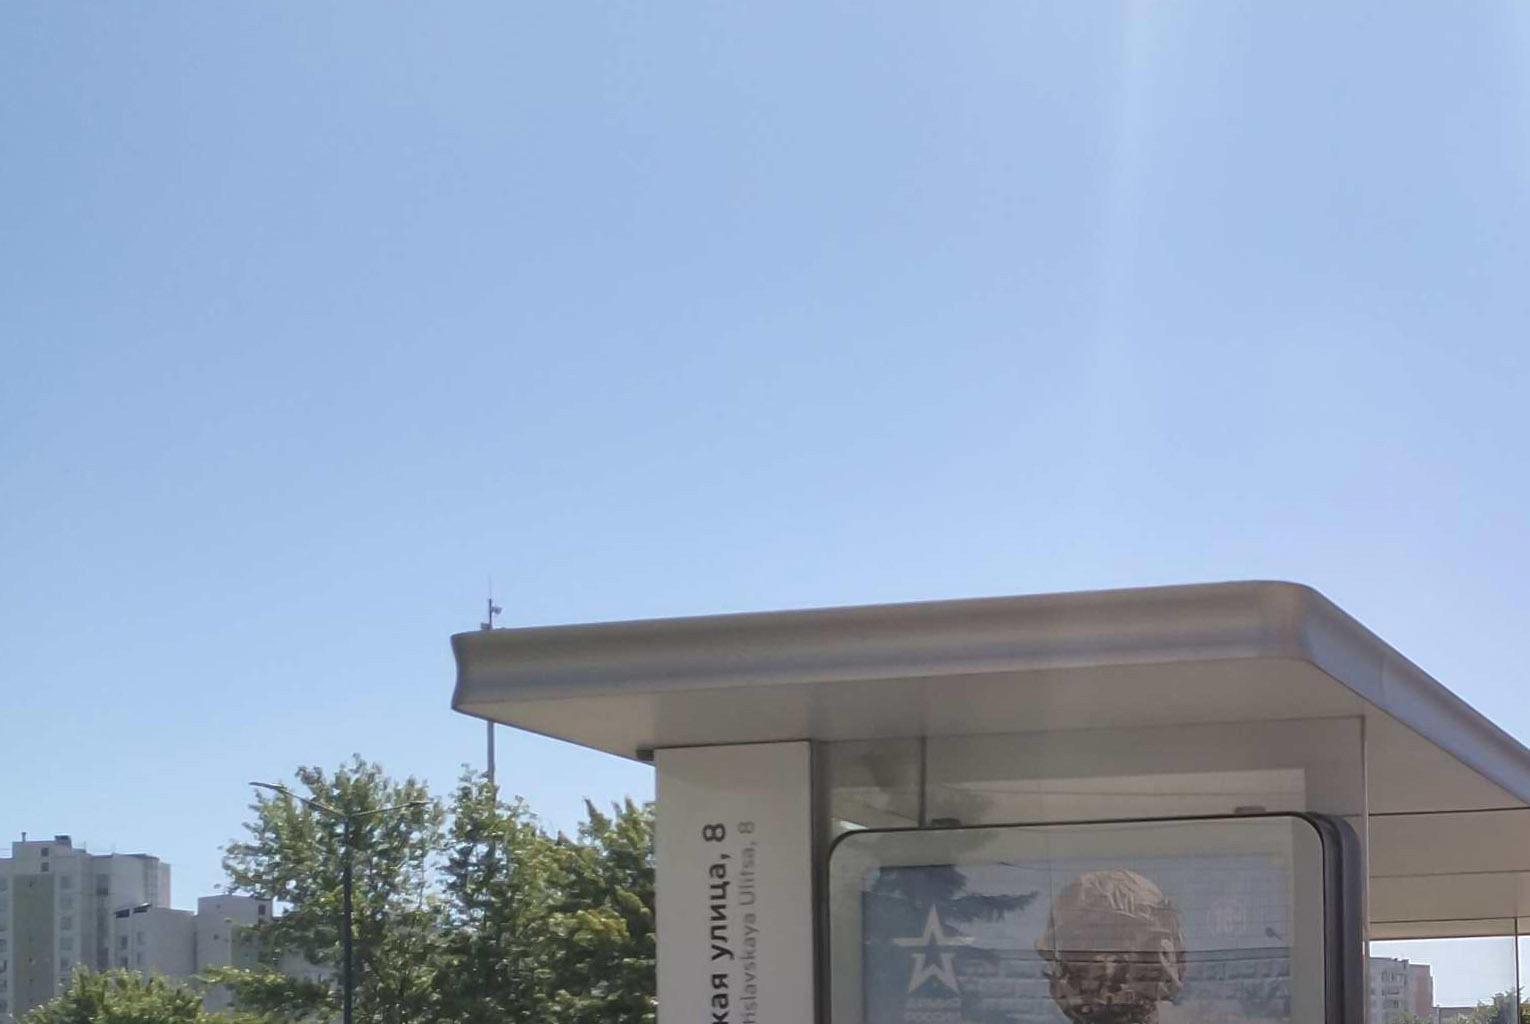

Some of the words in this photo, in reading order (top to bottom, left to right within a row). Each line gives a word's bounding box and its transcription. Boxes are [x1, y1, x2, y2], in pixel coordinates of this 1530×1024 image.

[702, 823, 726, 842] 8
[737, 821, 755, 835] 8
[738, 841, 758, 906] Ulitsa,
[709, 853, 735, 961] улица,
